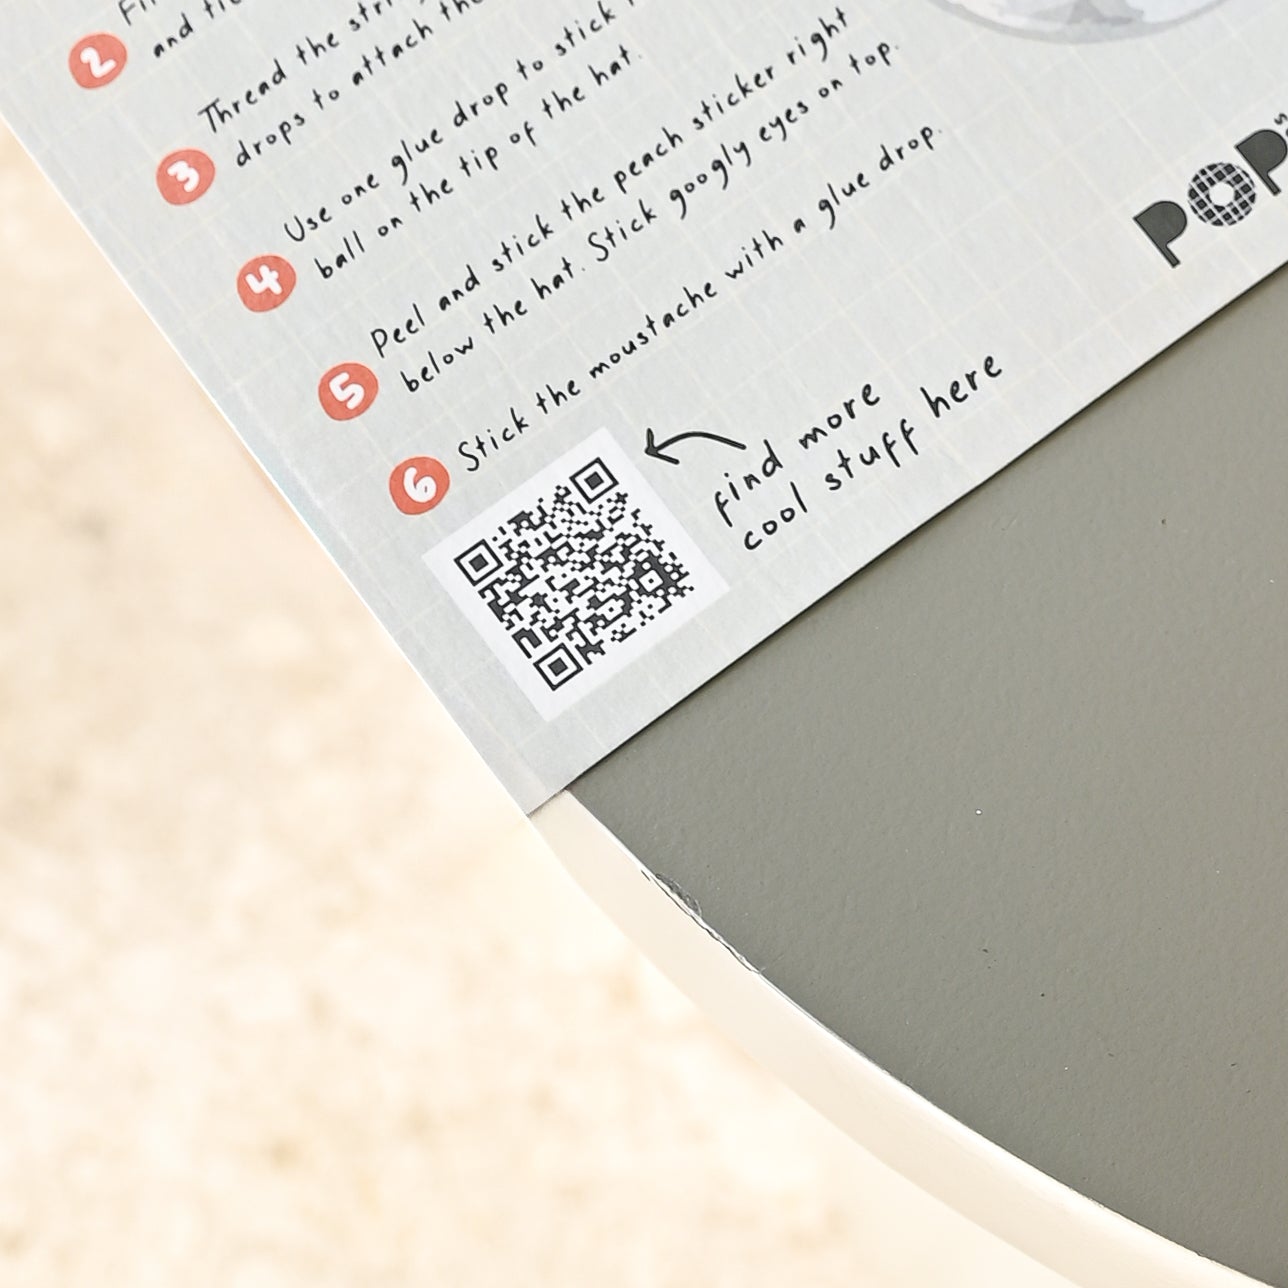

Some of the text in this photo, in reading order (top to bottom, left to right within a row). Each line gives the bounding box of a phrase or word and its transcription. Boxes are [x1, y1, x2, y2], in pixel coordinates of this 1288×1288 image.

[81, 47, 115, 77] 2
[152, 11, 194, 58] and
[168, 161, 199, 191] 3
[196, 57, 287, 133] Thread
[295, 31, 340, 65] the
[235, 112, 305, 167] drops
[311, 88, 340, 110] to
[351, 17, 434, 86] attach
[246, 265, 281, 294] 4
[283, 206, 332, 242] Use
[340, 172, 380, 205] one
[390, 128, 443, 186] glue
[452, 81, 508, 127] drop
[515, 58, 543, 80] to
[554, 0, 616, 56] stick
[313, 229, 365, 279] ball
[376, 216, 403, 237] on
[408, 177, 454, 213] the
[458, 145, 498, 177] tip
[508, 120, 537, 147] of
[541, 85, 586, 119] the
[330, 6, 847, 409] 5 Peel and stick the peach sticker right
[399, 335, 473, 392] below
[482, 299, 528, 334] the
[587, 198, 657, 262] Stick
[668, 140, 752, 220] googly
[758, 99, 809, 142] eyes
[817, 78, 843, 98] on
[1132, 129, 1288, 268] POP
[404, 467, 436, 502] 6
[457, 406, 529, 471] Stick
[535, 379, 581, 414] the
[588, 281, 718, 379] moustache
[724, 229, 784, 279] with
[792, 217, 806, 234] a
[817, 171, 870, 230] glue
[714, 383, 880, 528] find more
[743, 355, 1002, 550] cool stuff here
